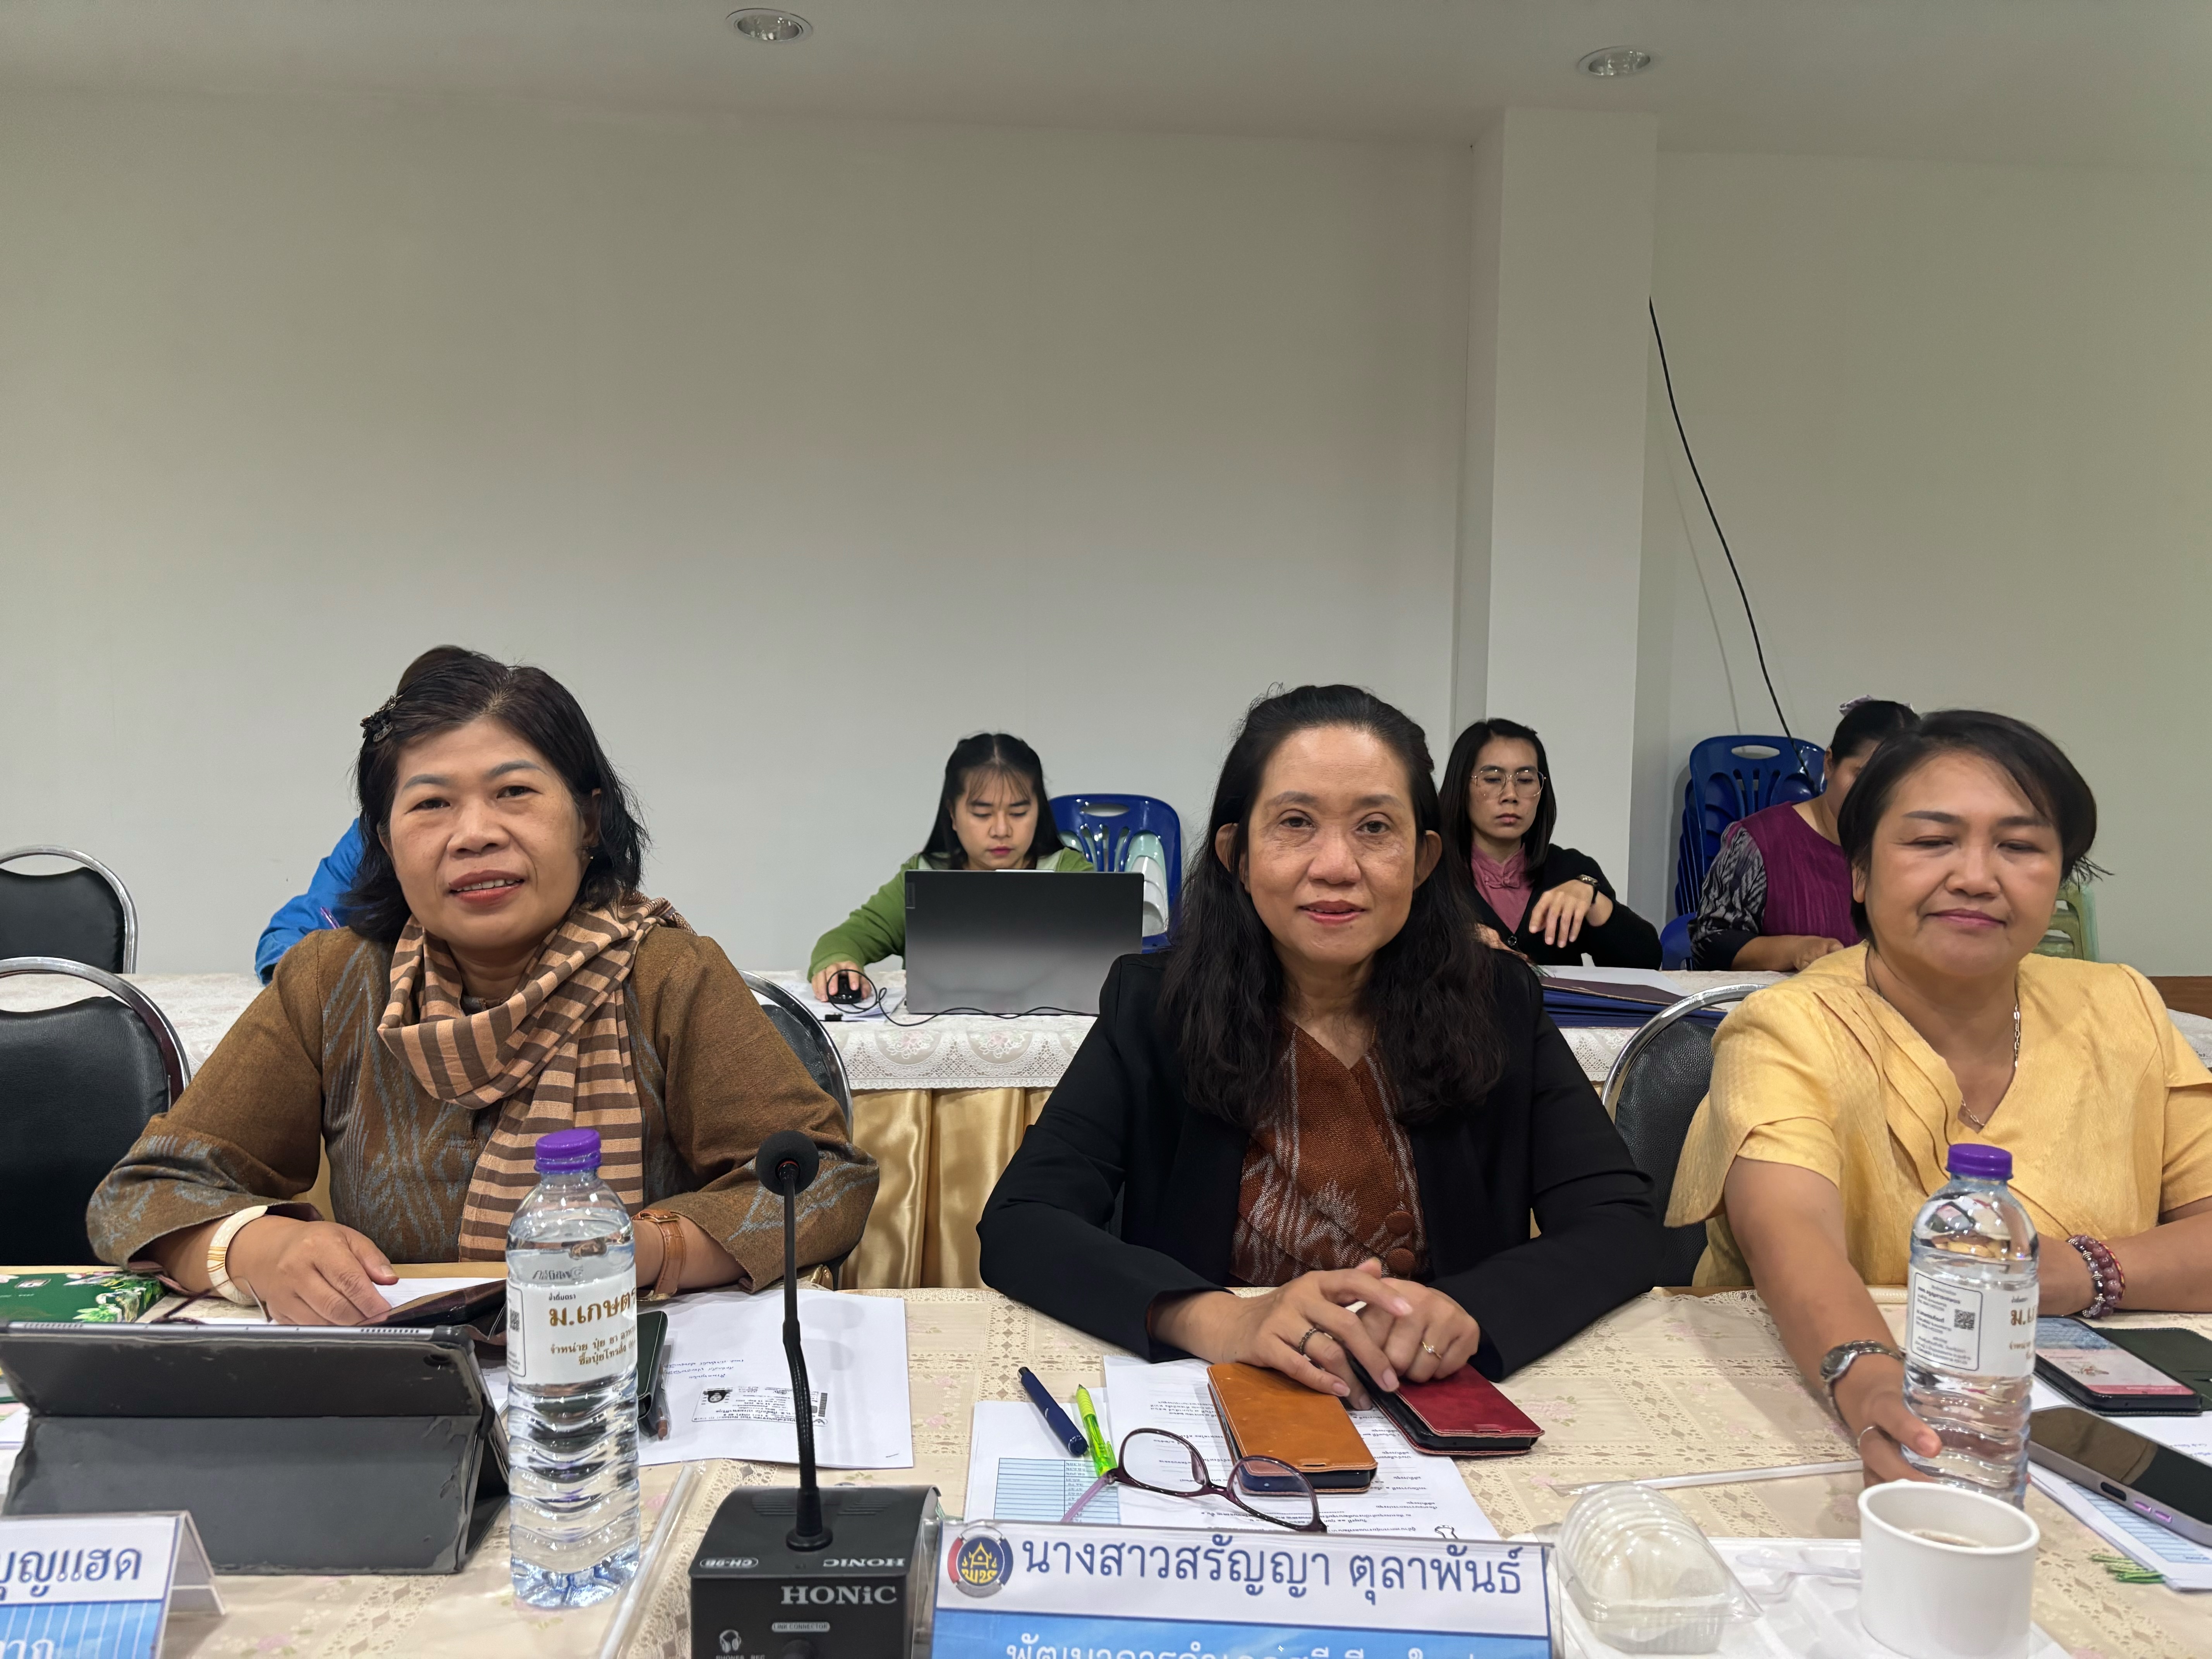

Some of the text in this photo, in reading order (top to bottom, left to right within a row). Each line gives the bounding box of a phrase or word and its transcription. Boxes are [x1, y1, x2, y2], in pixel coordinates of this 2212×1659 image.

[550, 1342, 588, 1354] จำหน่าย
[1023, 1533, 1523, 1606] นางสาวสรัญญา ตุลาพันธ์
